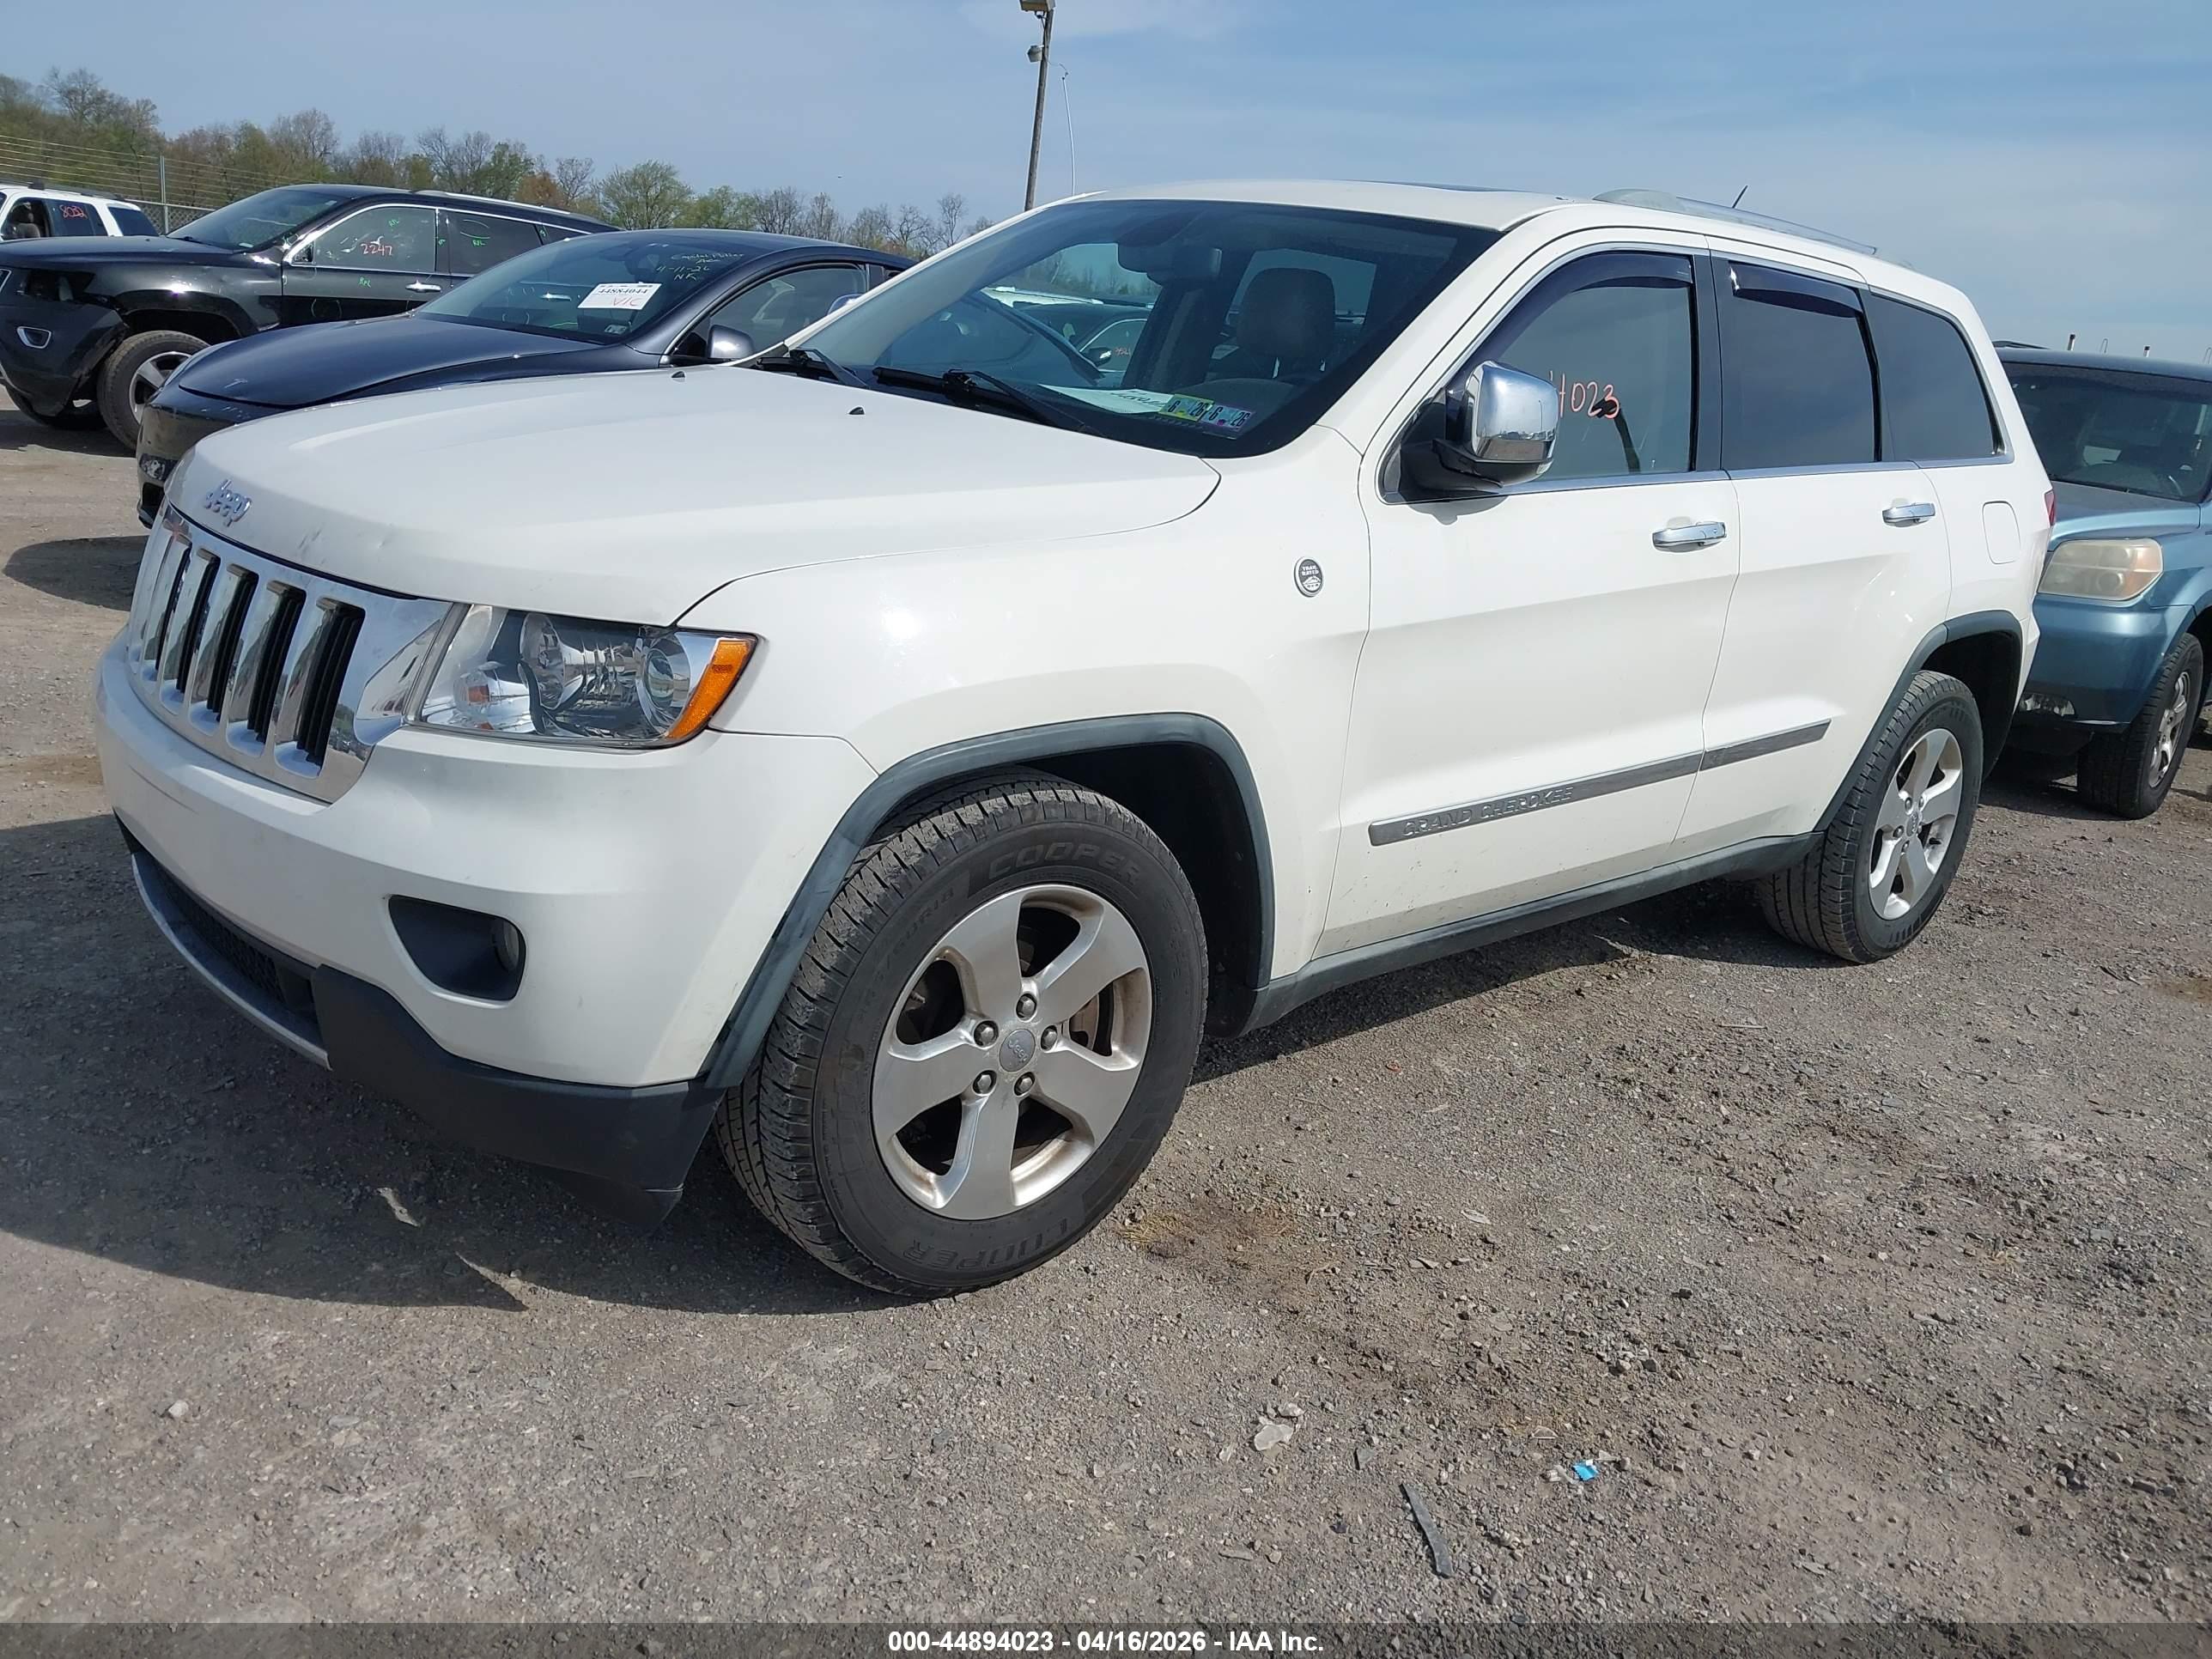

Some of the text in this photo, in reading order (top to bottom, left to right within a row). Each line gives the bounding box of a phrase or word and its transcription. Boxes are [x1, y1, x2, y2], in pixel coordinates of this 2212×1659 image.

[361, 243, 393, 256] 2247
[1168, 400, 1181, 413] 6
[1209, 406, 1250, 427] 6 26
[204, 479, 252, 527] Jeep
[1402, 787, 1575, 836] GRAND CHEROKEE
[988, 842, 1140, 885] COOPER
[1007, 1039, 1029, 1063] Jeep
